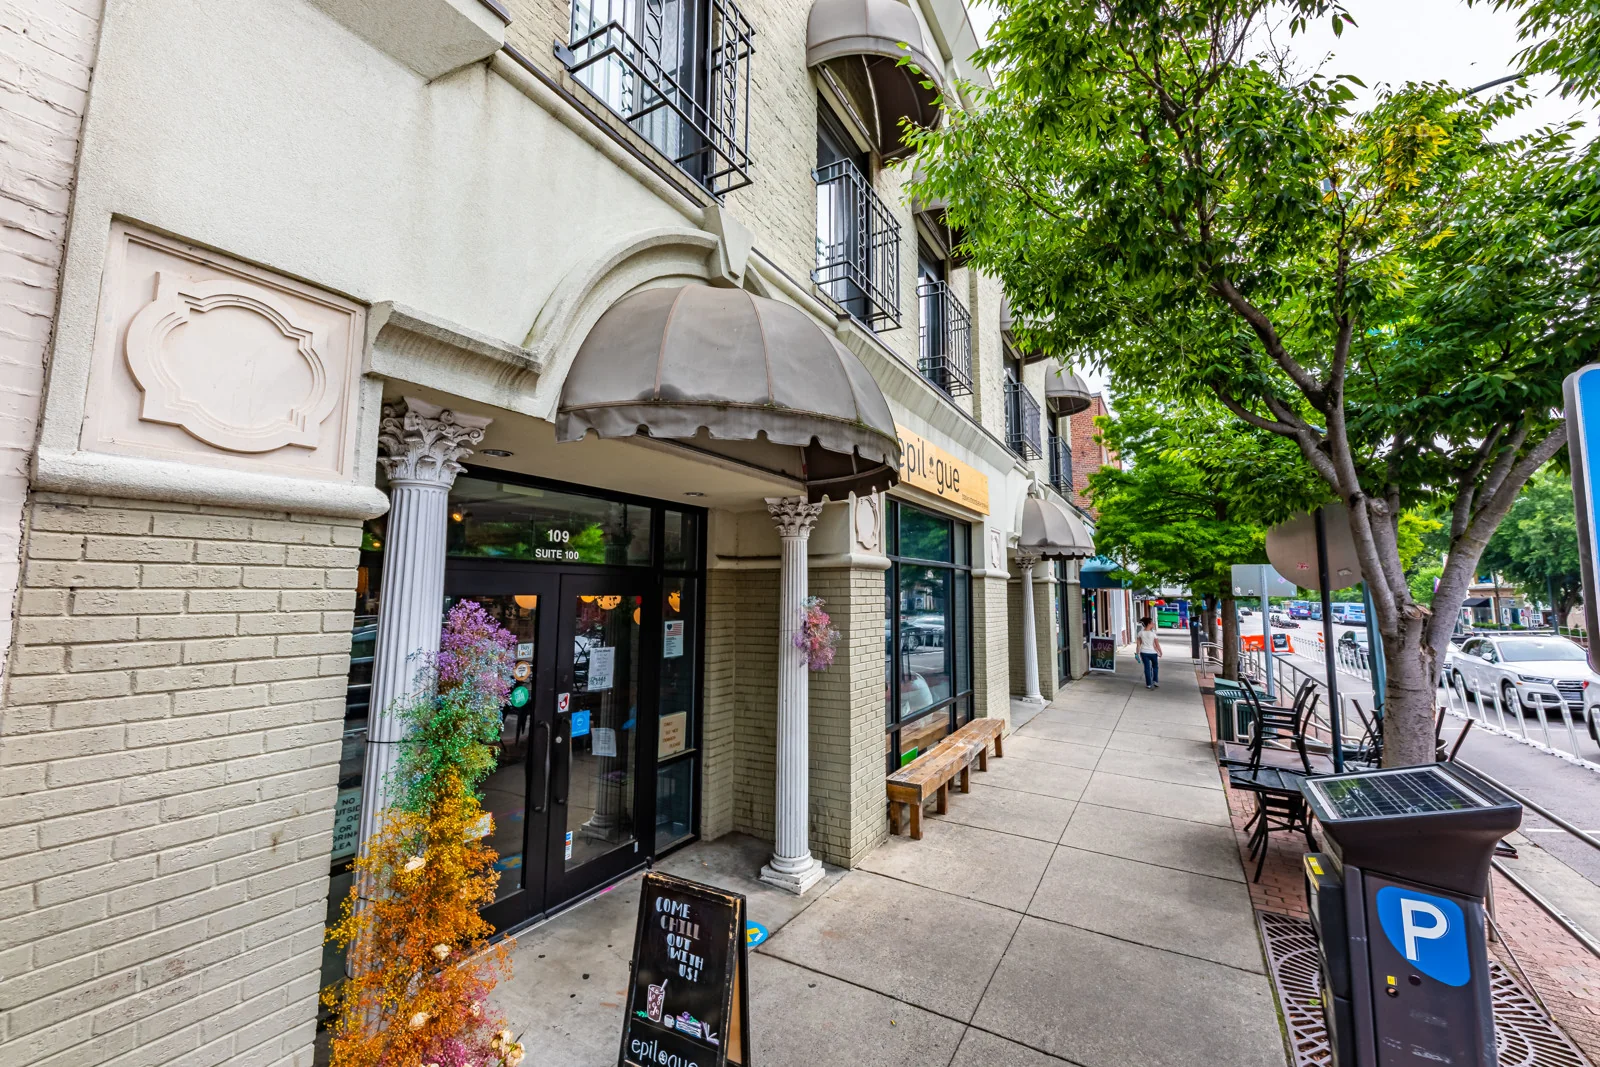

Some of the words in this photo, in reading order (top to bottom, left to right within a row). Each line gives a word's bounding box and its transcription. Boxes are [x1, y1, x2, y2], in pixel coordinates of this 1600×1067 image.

[547, 529, 570, 543] 109
[535, 548, 563, 559] SUITE
[564, 550, 579, 560] 100
[1091, 642, 1113, 652] LOVE
[1091, 658, 1113, 669] LOVE
[341, 797, 356, 806] NO
[335, 804, 361, 817] UTSID
[339, 824, 352, 833] OR
[655, 896, 691, 919] COME
[660, 914, 701, 940] CHILL
[1400, 897, 1451, 962] P
[666, 932, 692, 951] OUT
[668, 946, 704, 971] WITH
[678, 963, 699, 982] US!
